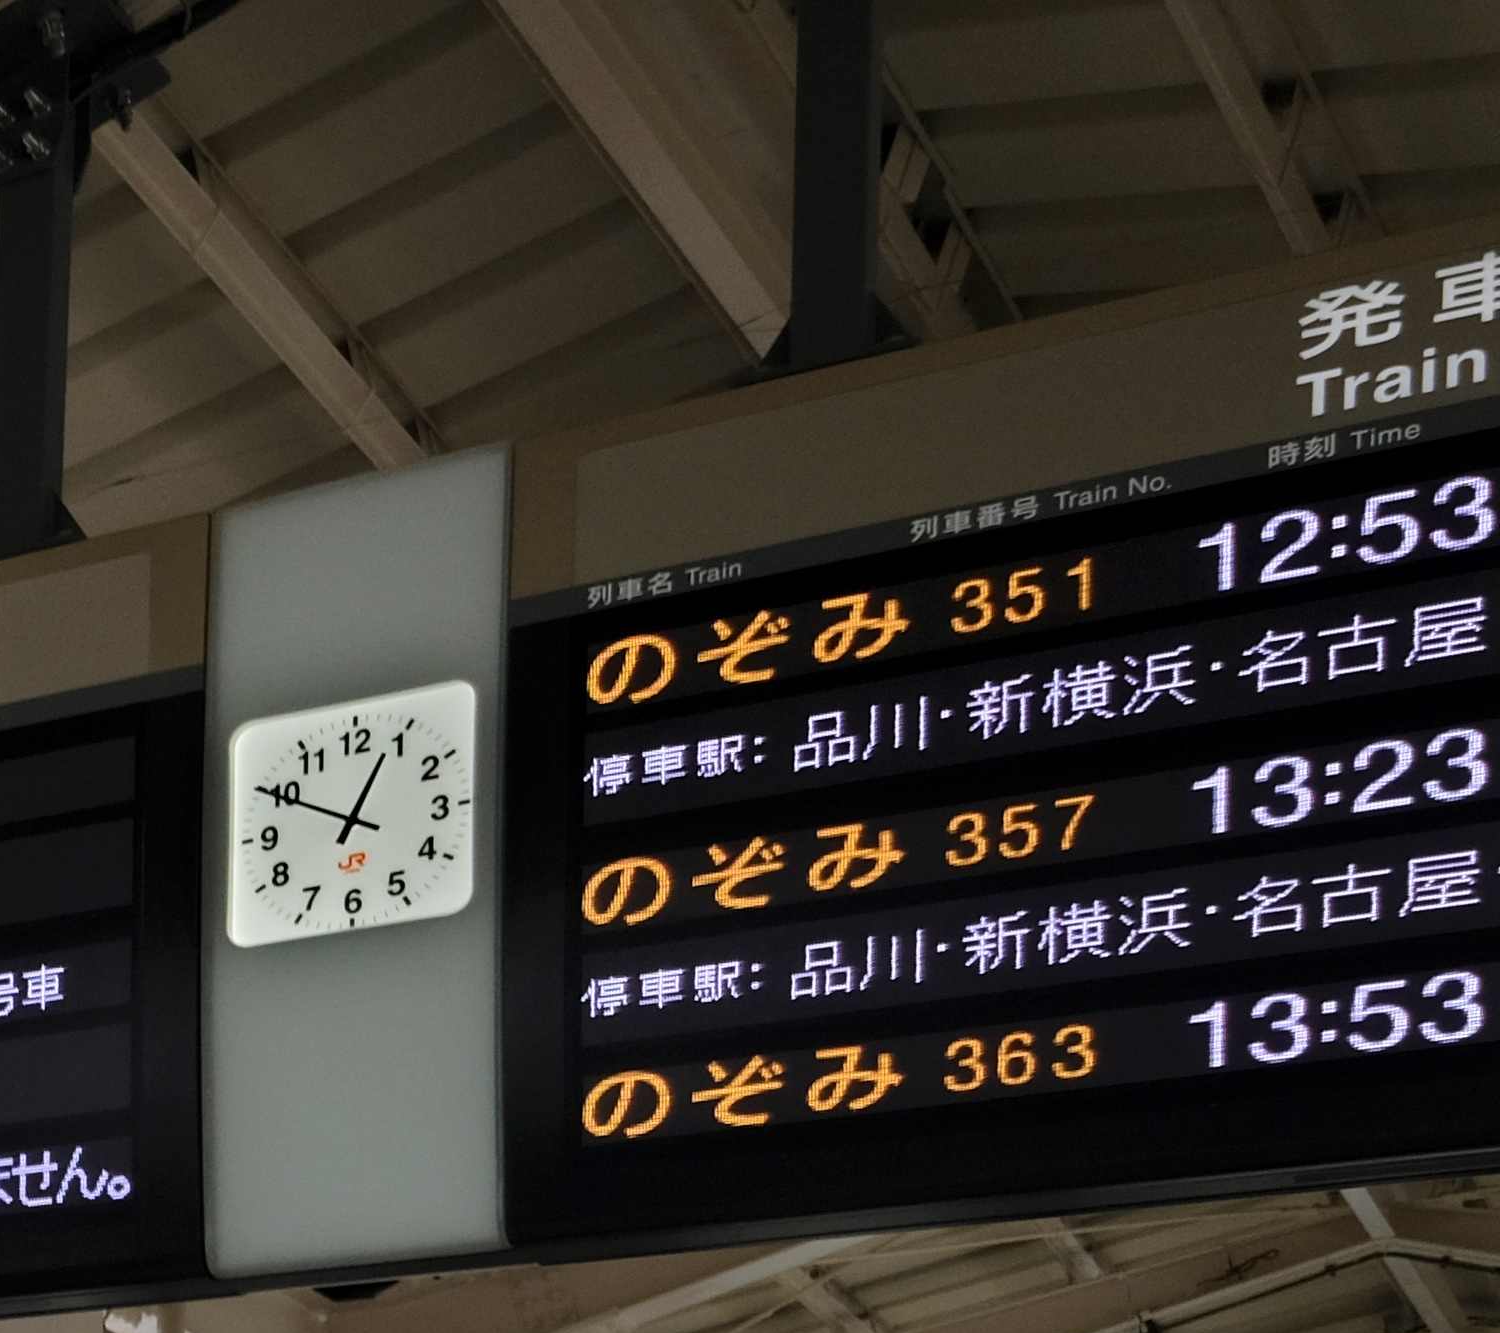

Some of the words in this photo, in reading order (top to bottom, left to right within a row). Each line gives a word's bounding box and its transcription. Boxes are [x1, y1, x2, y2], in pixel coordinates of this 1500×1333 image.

[1297, 347, 1488, 418] Train
[1268, 434, 1336, 469] 時刻
[1351, 421, 1421, 451] Time
[909, 495, 1039, 544] 列車番号
[1054, 483, 1117, 510] Train
[1128, 473, 1172, 496] No.
[586, 592, 910, 705] のぞみ
[950, 556, 1095, 635] 351
[1199, 474, 1498, 591] 12:53
[587, 571, 673, 609] 列車名
[685, 560, 742, 586] Train
[339, 728, 371, 756] 12
[392, 732, 404, 757] 1
[298, 748, 325, 776] 11
[420, 755, 440, 782] 2
[270, 781, 300, 808] 10
[431, 795, 450, 821] 3
[260, 826, 279, 850] 9
[581, 823, 906, 926] のぞみ
[945, 795, 1095, 867] 357
[1191, 728, 1490, 834] 13:23
[338, 852, 367, 870] JR
[418, 836, 437, 861] 4
[271, 861, 290, 887] 8
[387, 870, 406, 896] 5
[302, 885, 321, 911] 7
[344, 888, 362, 914] 6
[581, 1046, 906, 1138] のぞみ
[944, 1023, 1097, 1092] 363
[1189, 971, 1485, 1068] 13:53
